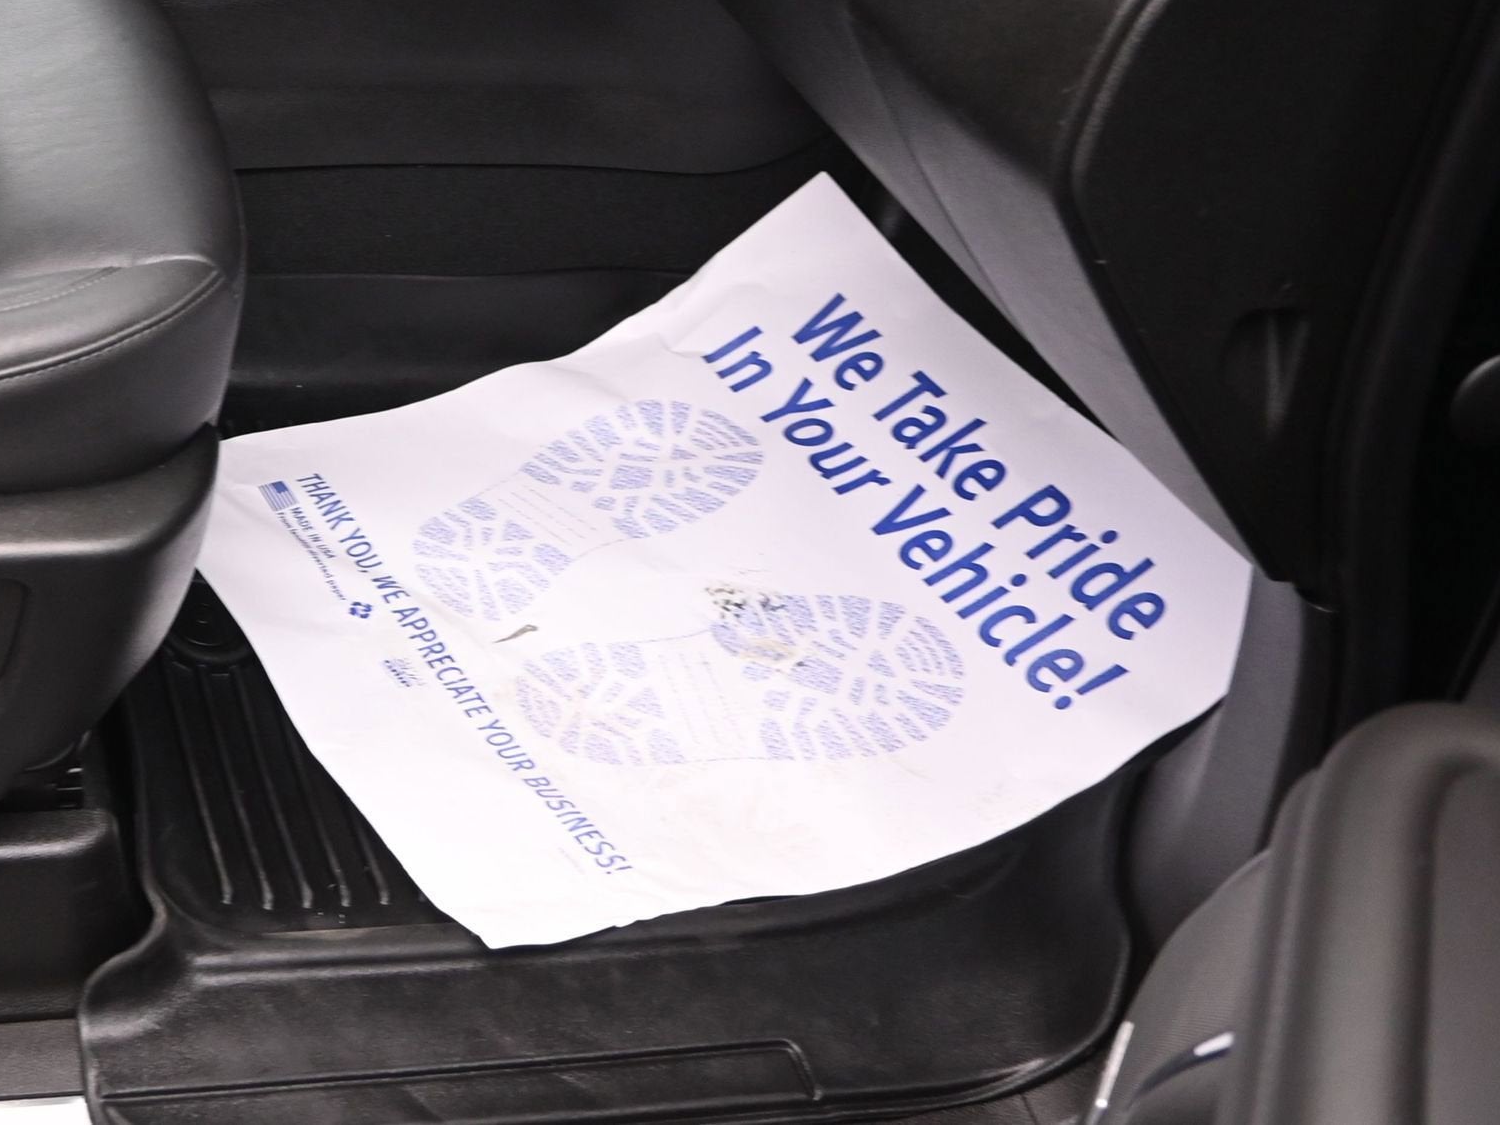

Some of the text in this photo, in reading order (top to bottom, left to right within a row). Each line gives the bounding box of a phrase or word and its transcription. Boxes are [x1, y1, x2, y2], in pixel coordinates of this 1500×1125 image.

[290, 506, 337, 559] MADE IN USA
[701, 325, 1130, 710] In Your Vehicle!
[791, 292, 1166, 641] We Take Pride
[295, 473, 356, 530] THANK
[338, 527, 383, 573] YOU,
[371, 575, 411, 604] WE
[391, 606, 493, 718] APPRECIATE
[477, 719, 536, 772] YOUR
[523, 776, 633, 875] BUSINESS!
